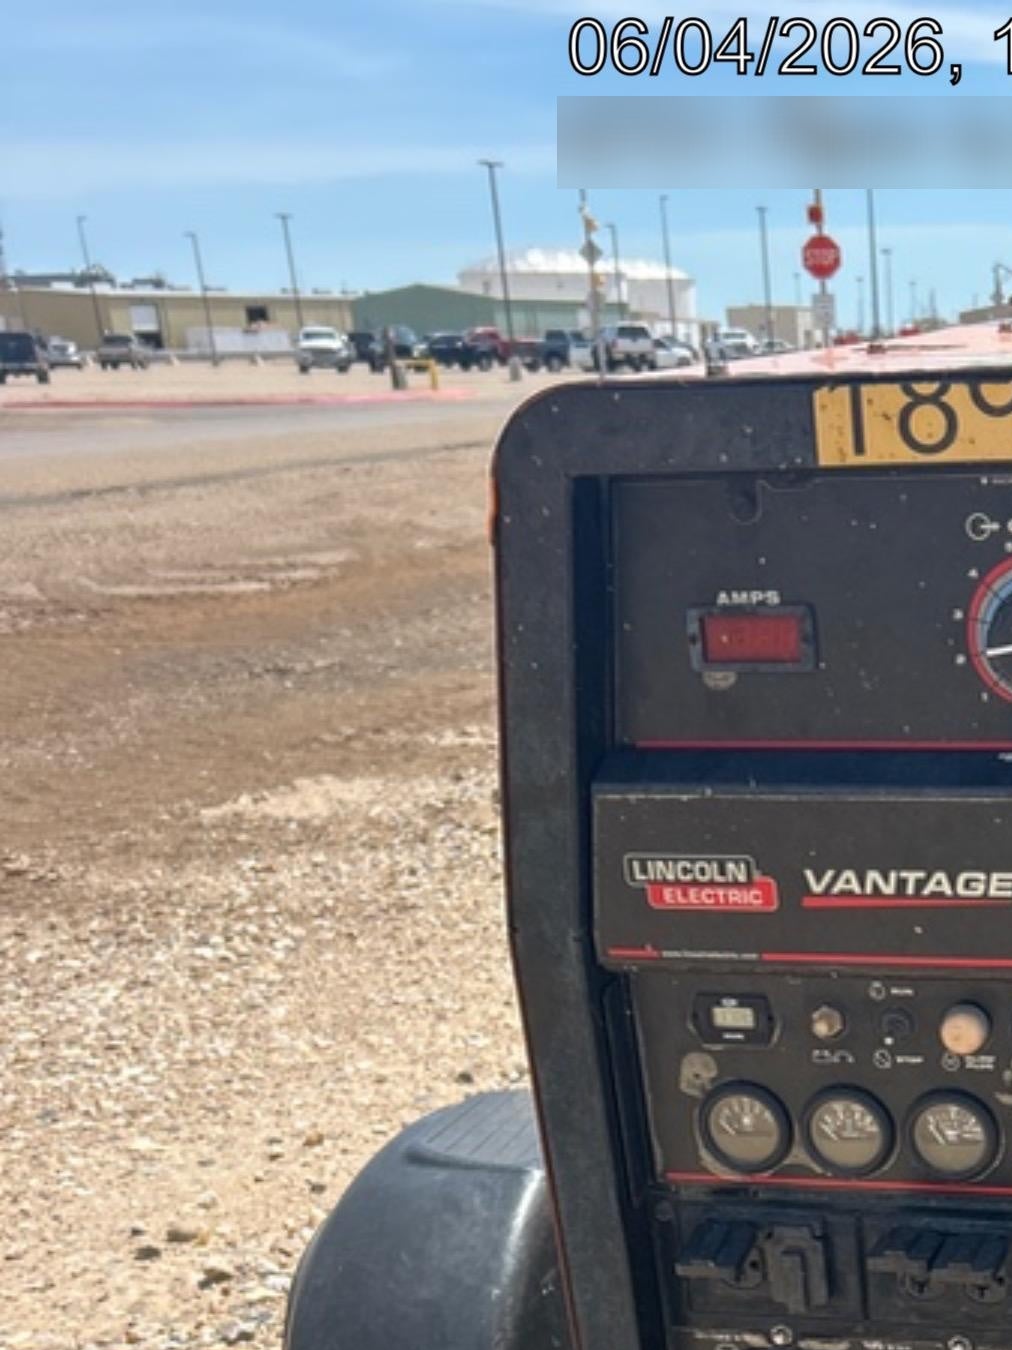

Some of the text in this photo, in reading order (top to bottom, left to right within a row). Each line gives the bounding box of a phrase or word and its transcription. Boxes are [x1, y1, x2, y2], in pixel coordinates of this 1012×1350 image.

[716, 590, 781, 605] AMPS
[632, 860, 748, 883] LINCOLN
[663, 887, 763, 906] ELECTRIC
